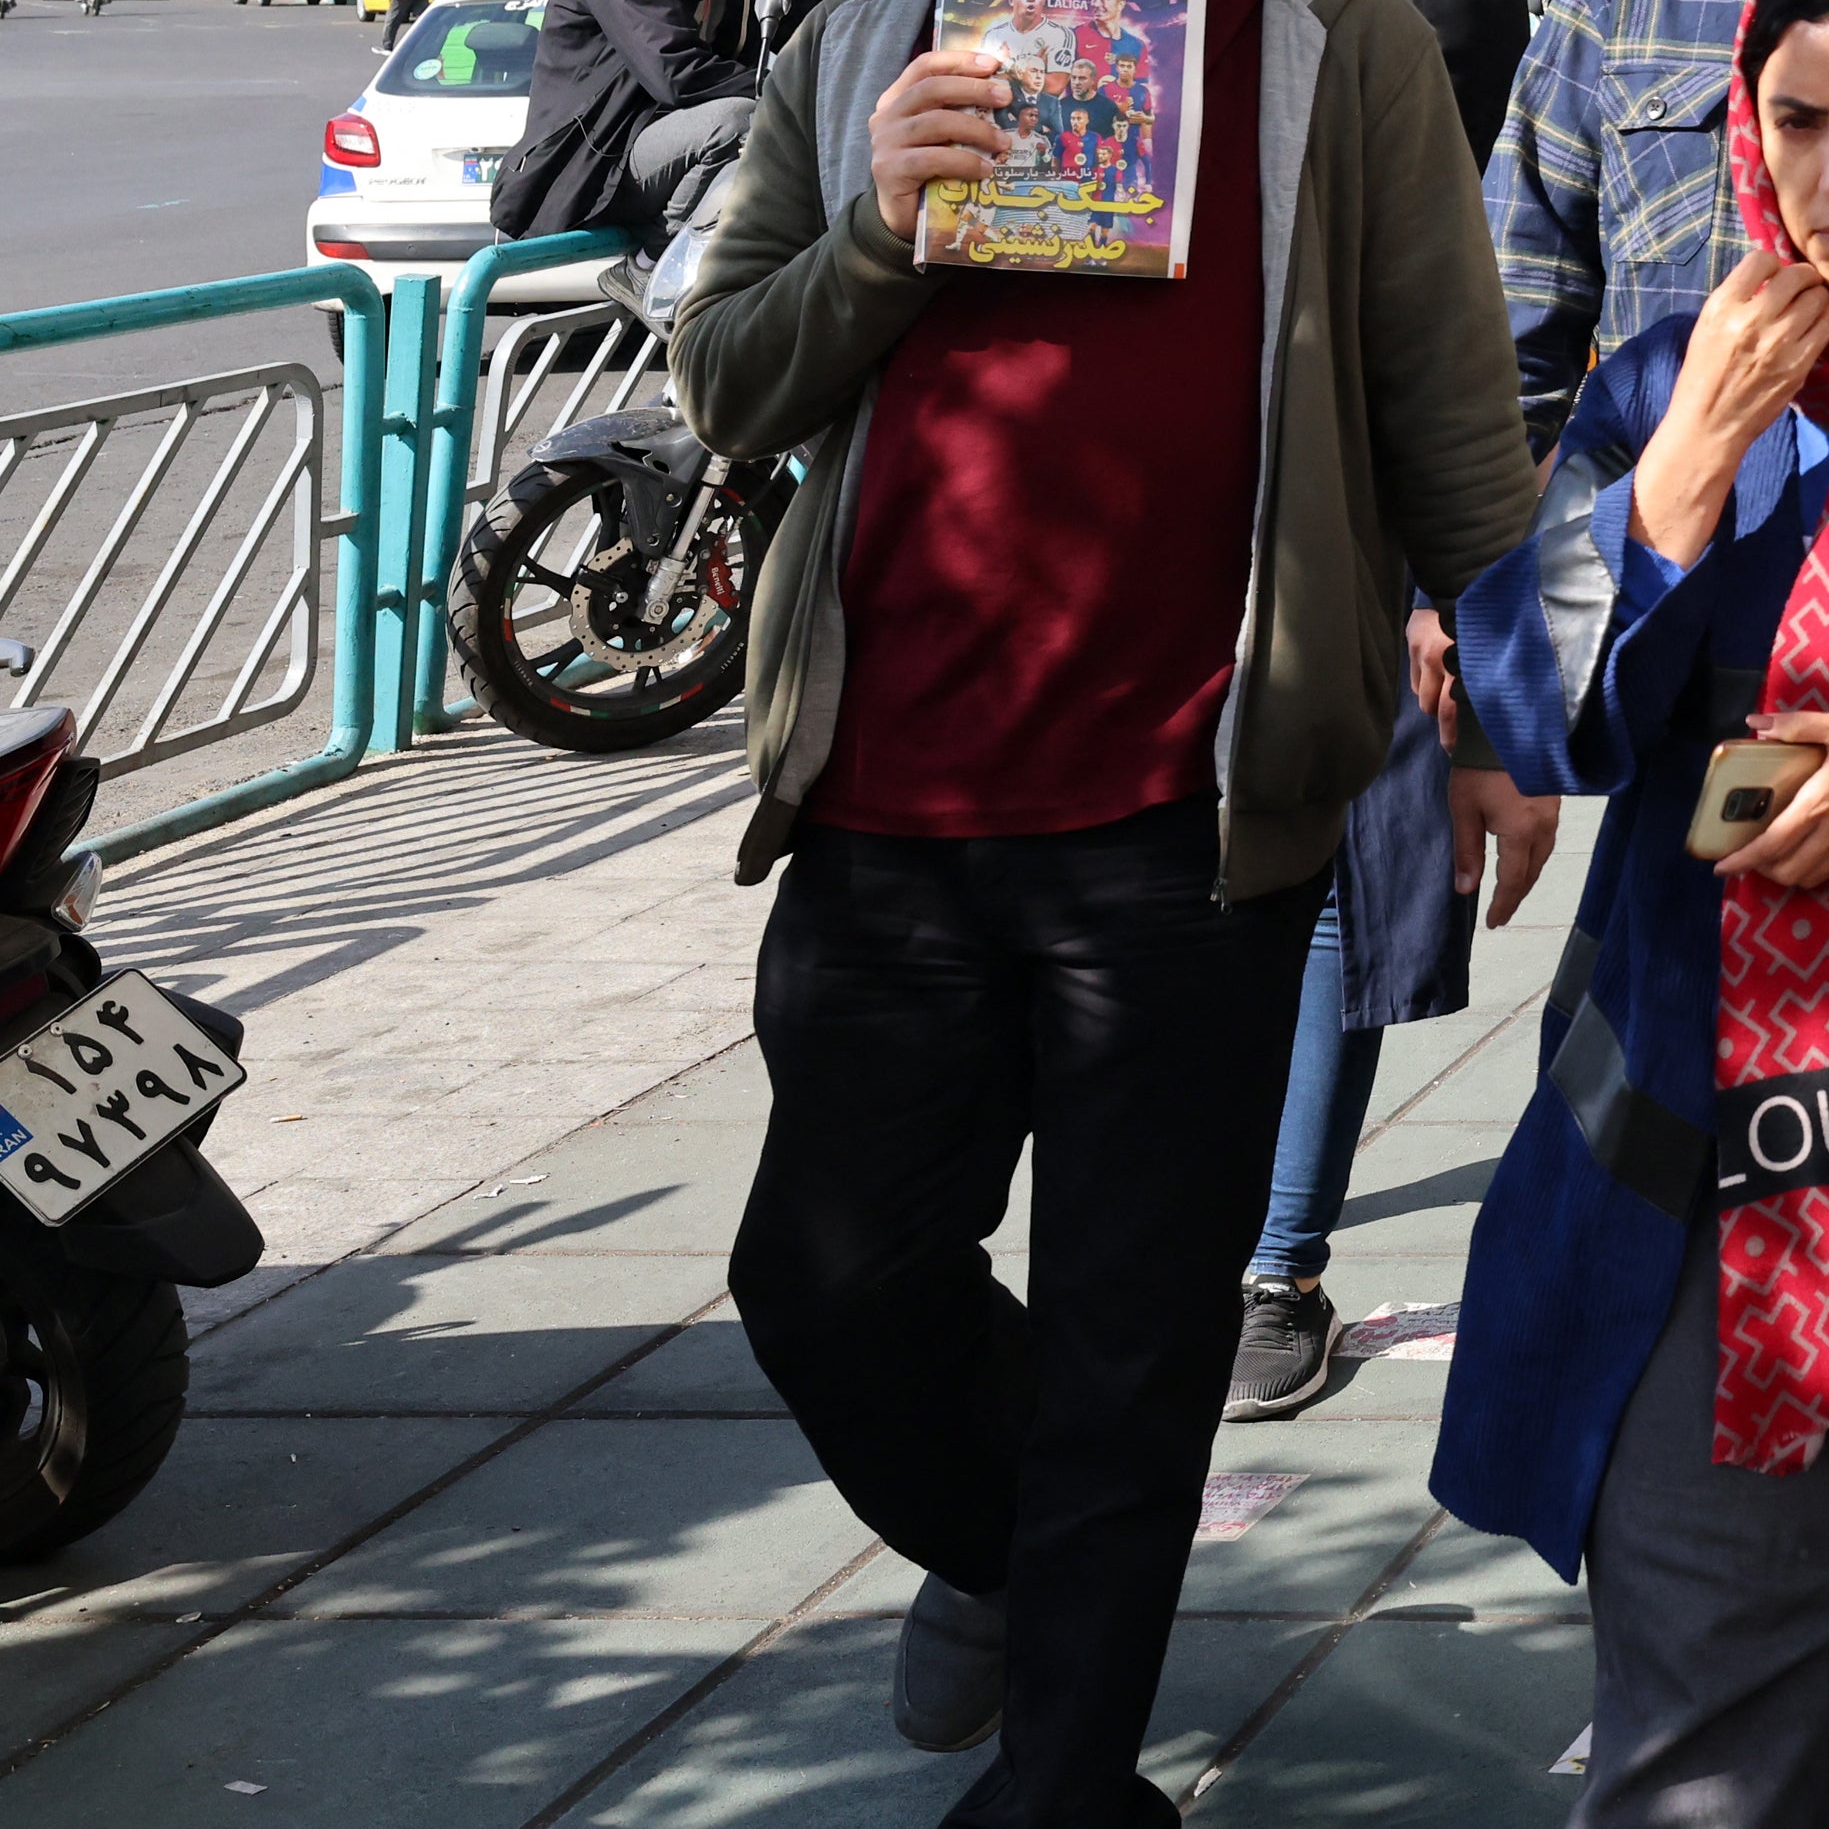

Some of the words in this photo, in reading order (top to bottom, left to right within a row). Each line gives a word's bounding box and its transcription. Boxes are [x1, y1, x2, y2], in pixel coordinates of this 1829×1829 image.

[937, 174, 1057, 219] جذاب
[1057, 180, 1165, 225] جنگ
[968, 223, 1127, 269] صدرنشینی
[709, 566, 726, 597] Benelli
